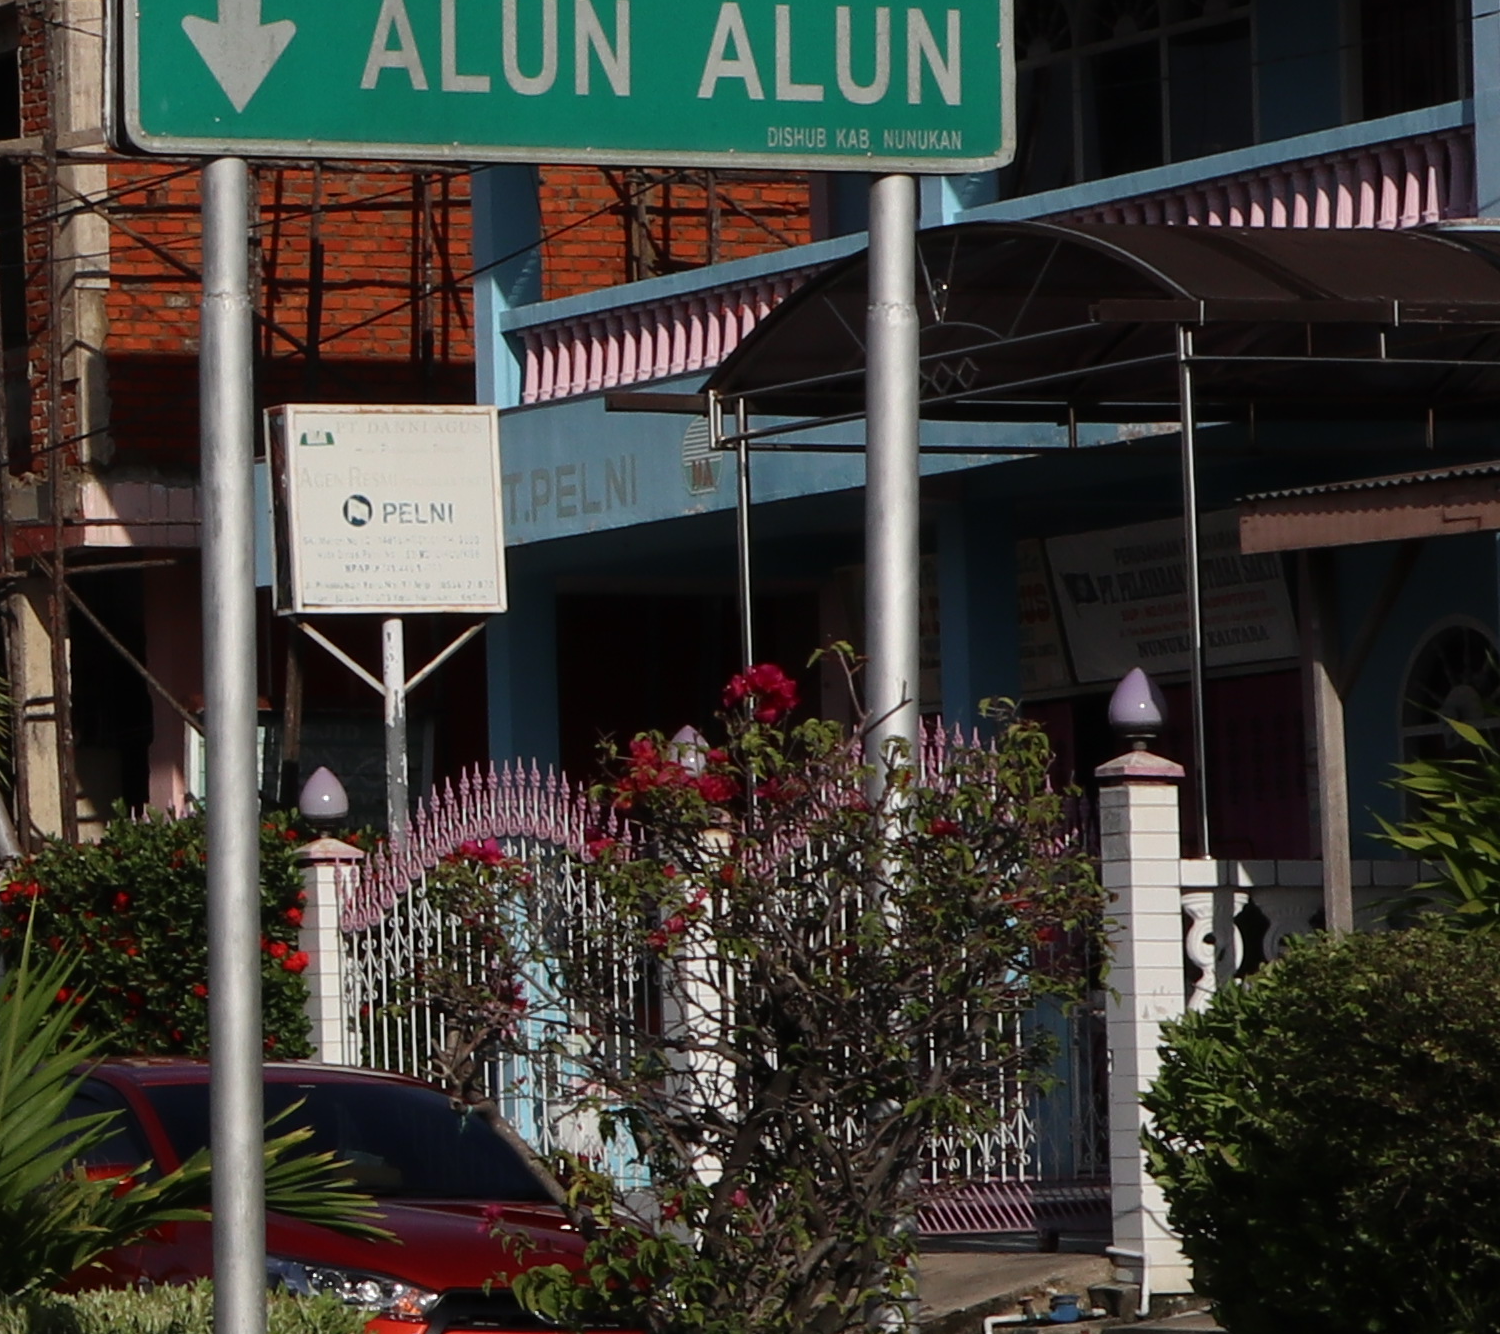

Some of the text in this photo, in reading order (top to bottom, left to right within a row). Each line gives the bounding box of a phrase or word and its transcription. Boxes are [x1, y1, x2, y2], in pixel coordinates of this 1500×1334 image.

[696, 1, 962, 106] ALUN
[766, 126, 828, 148] DISHUB
[883, 128, 963, 151] NUNUKAN
[381, 501, 455, 525] PELNI
